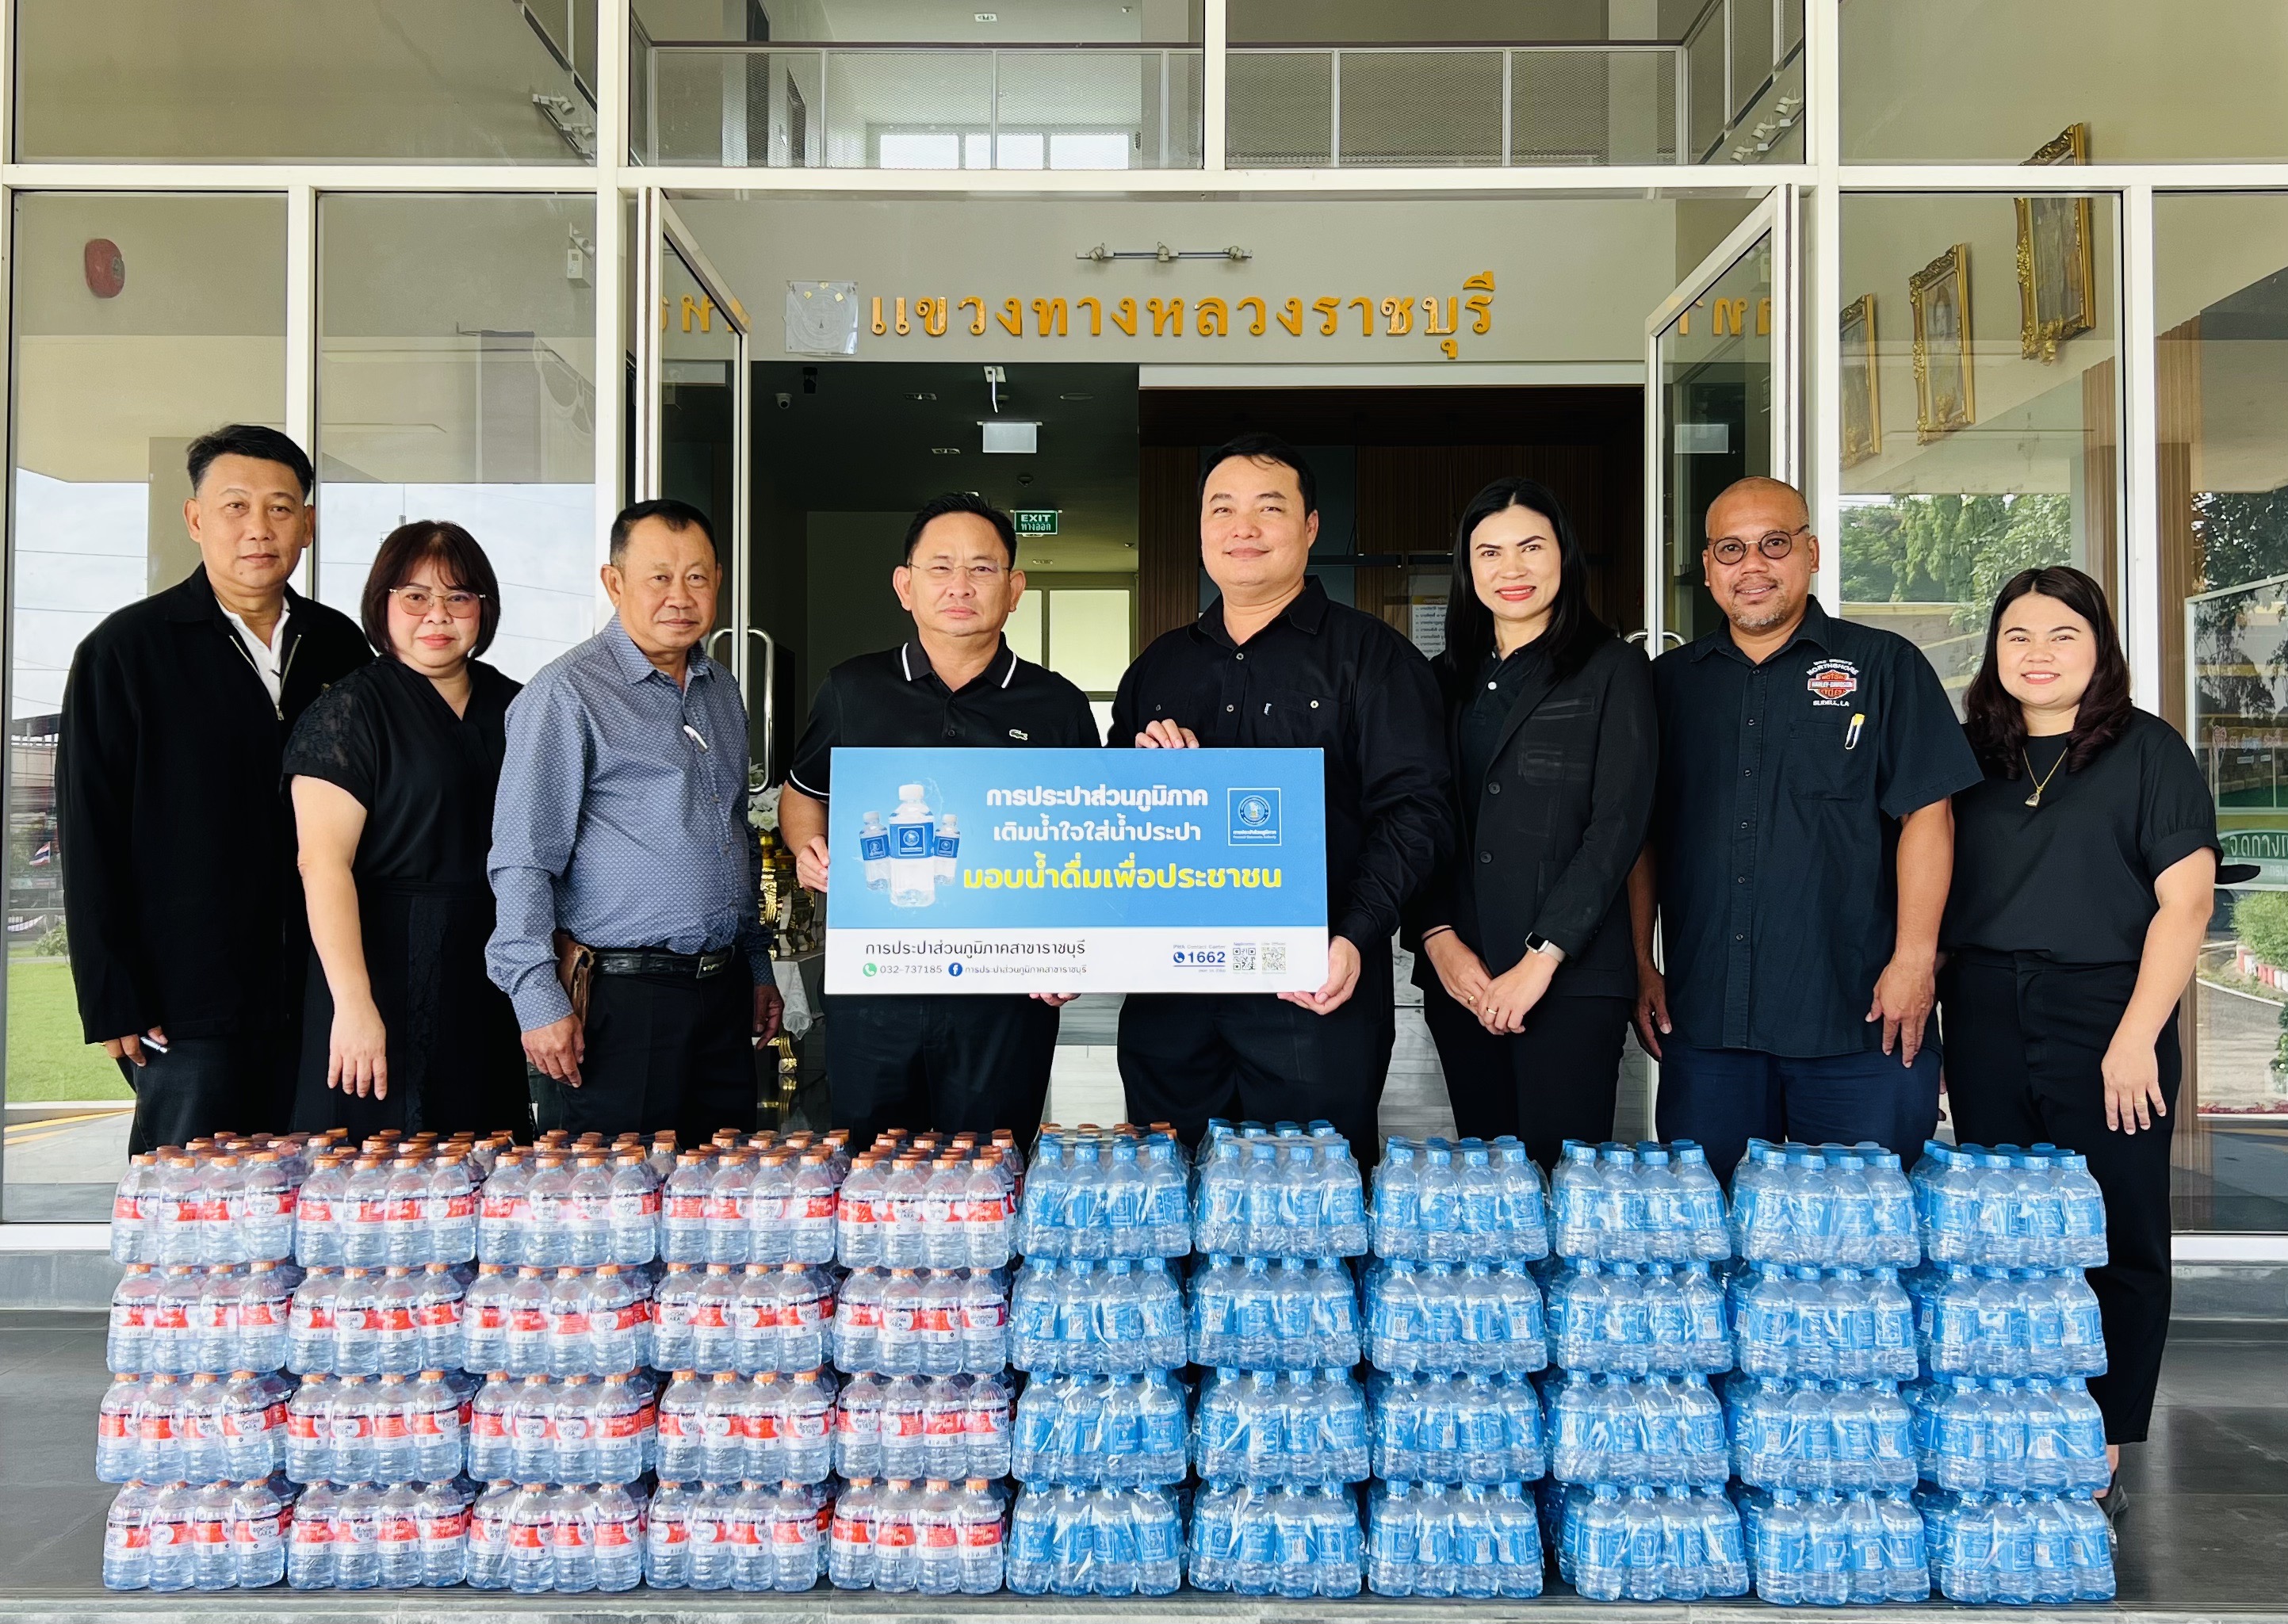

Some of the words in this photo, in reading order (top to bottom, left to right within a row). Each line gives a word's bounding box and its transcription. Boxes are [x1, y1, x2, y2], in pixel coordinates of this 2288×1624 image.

[870, 271, 1495, 359] แขวงทางหลวงราชบุรี
[1020, 522, 1051, 531] ทางออก
[986, 783, 1208, 812] การประปาส่วนภูมิภาค
[993, 813, 1202, 841] เติมน้ำใจใส่น้ำประปา
[963, 852, 1282, 889] มอบน้ำดื่มเพื่อประชาชน
[865, 938, 1086, 960] การประปาส่วนภูมิภาคสาขาราชบุรี
[1188, 951, 1226, 963] 1662
[880, 964, 943, 975] 032-737185
[965, 962, 1087, 976] การประปาส่วนภูมิภาคสาขาราชบุรี
